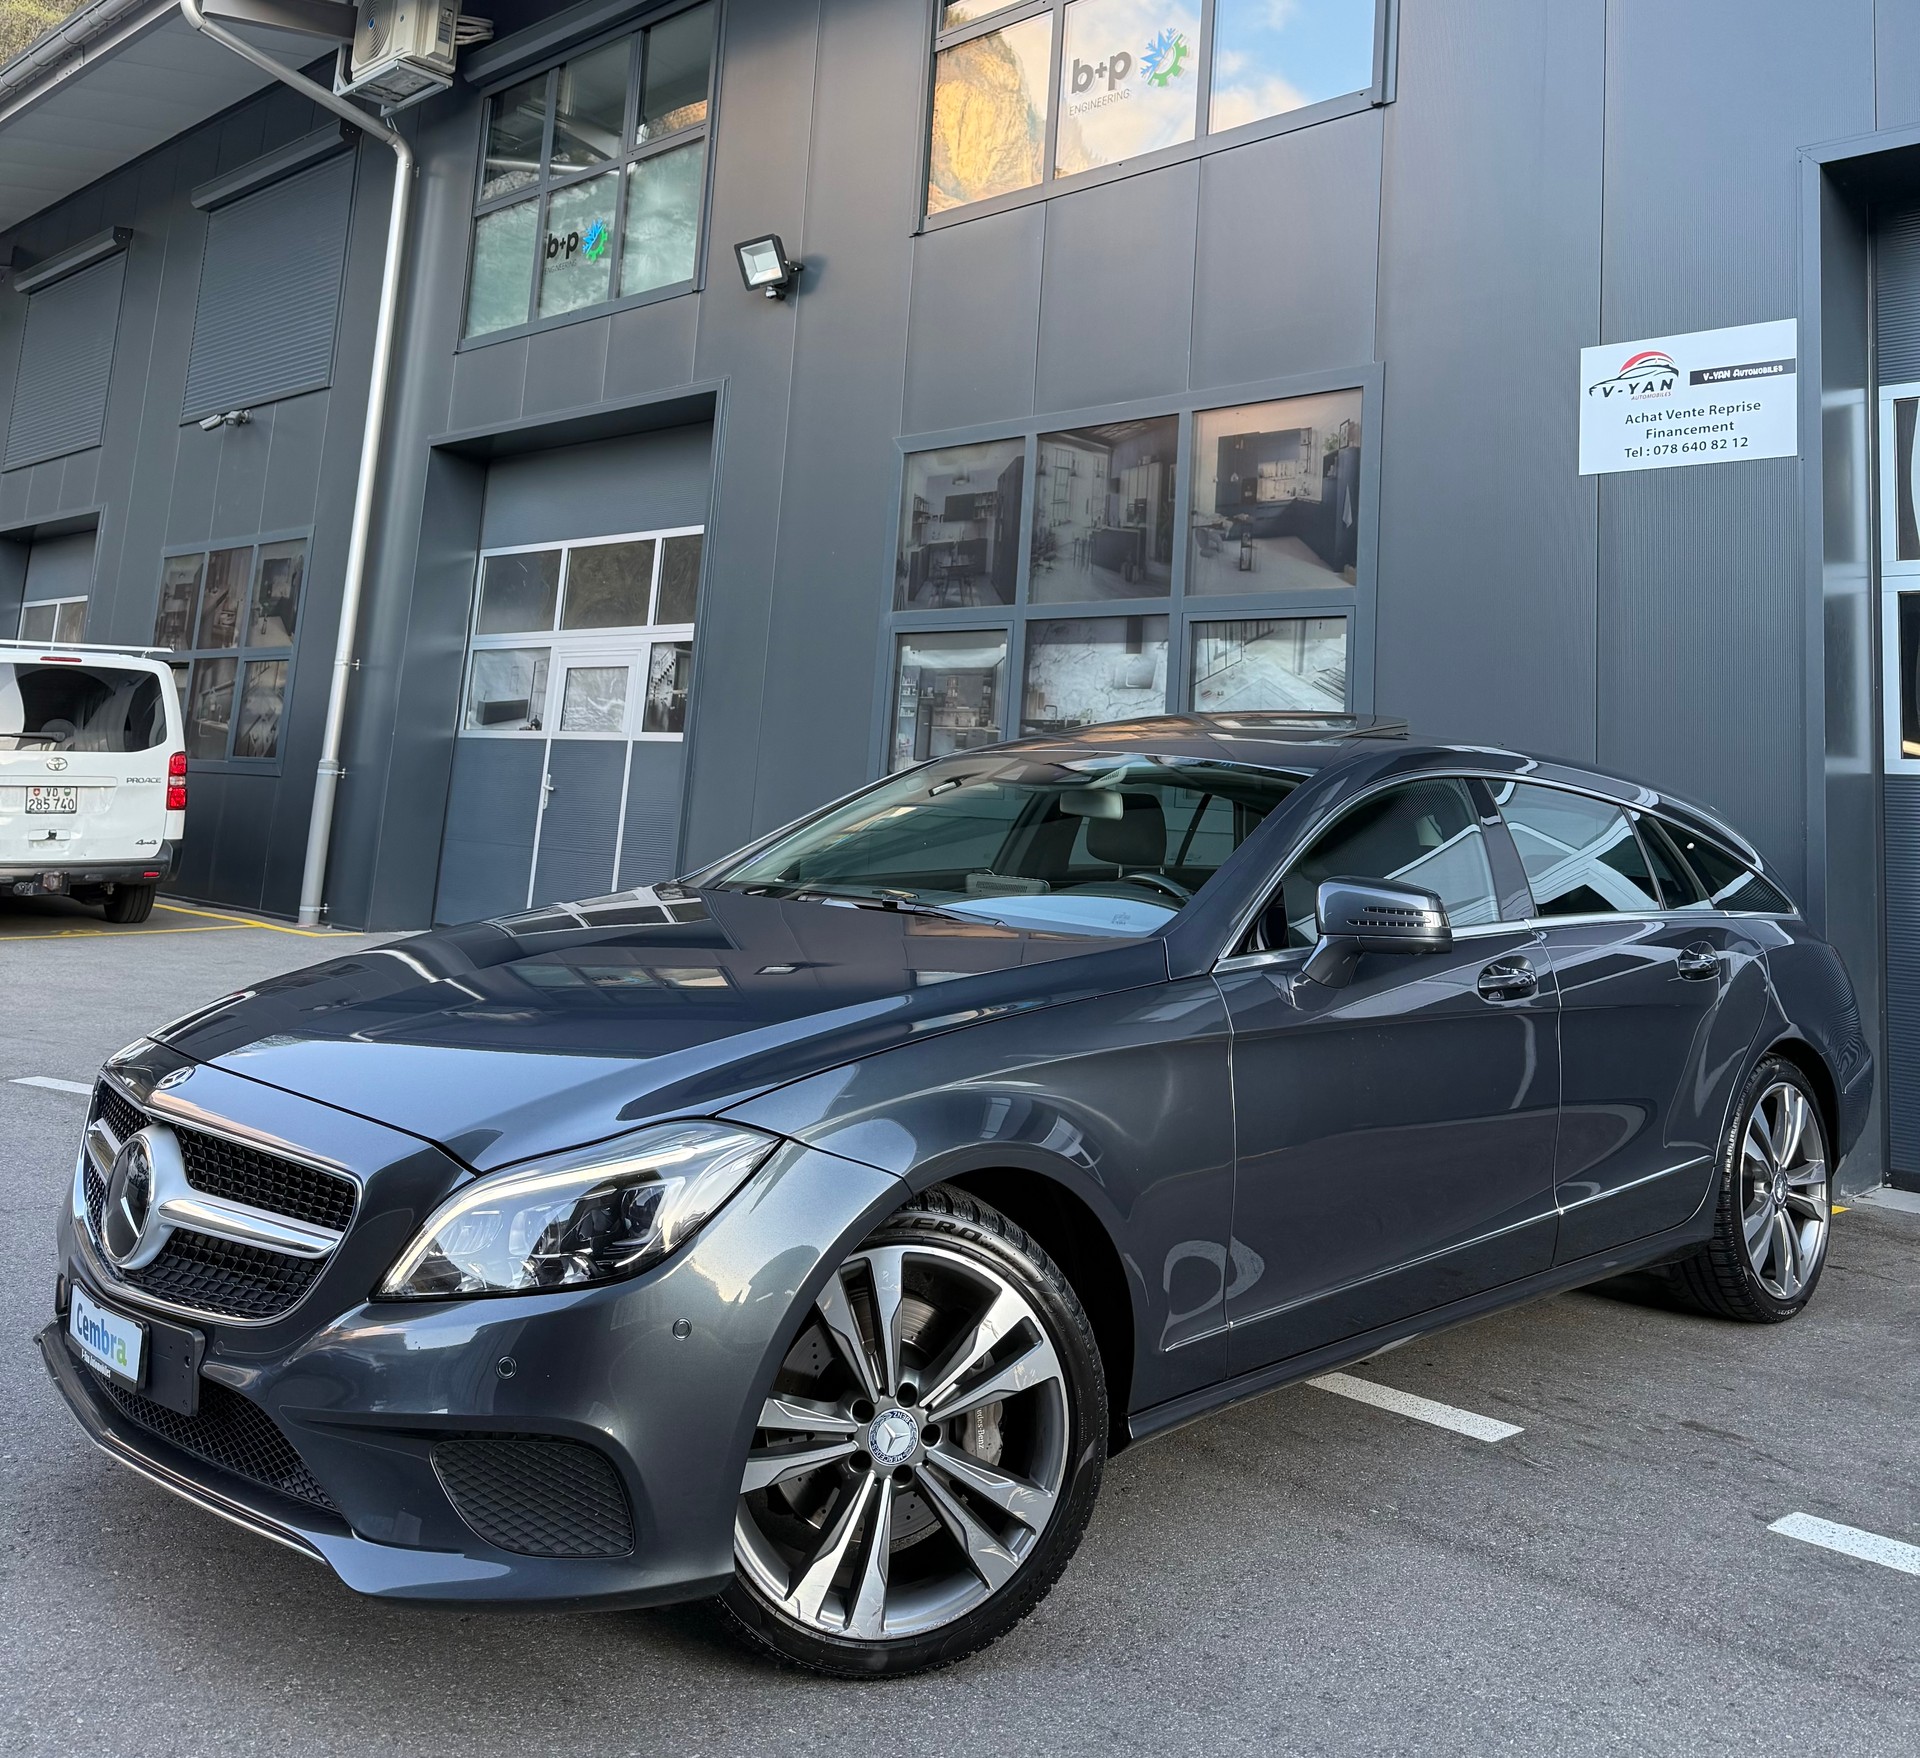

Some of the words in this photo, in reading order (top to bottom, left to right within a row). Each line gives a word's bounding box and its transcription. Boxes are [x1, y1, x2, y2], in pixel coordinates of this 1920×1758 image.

[1071, 51, 1132, 94] b+p
[1069, 88, 1131, 116] ENGINEERING
[546, 232, 579, 260] b+p
[1702, 369, 1731, 381] V-YAN
[1631, 391, 1671, 401] AUTOMOBILES
[1625, 412, 1663, 425] Achat
[1665, 407, 1705, 420] Vente
[1709, 401, 1761, 417] Reprise
[1646, 421, 1735, 439] Financement
[1653, 443, 1678, 456] 078
[1681, 441, 1707, 453] 640
[1711, 438, 1728, 450] 82
[1733, 436, 1749, 448] 12
[887, 1216, 983, 1243] ZERO
[76, 1302, 127, 1367] Cembra
